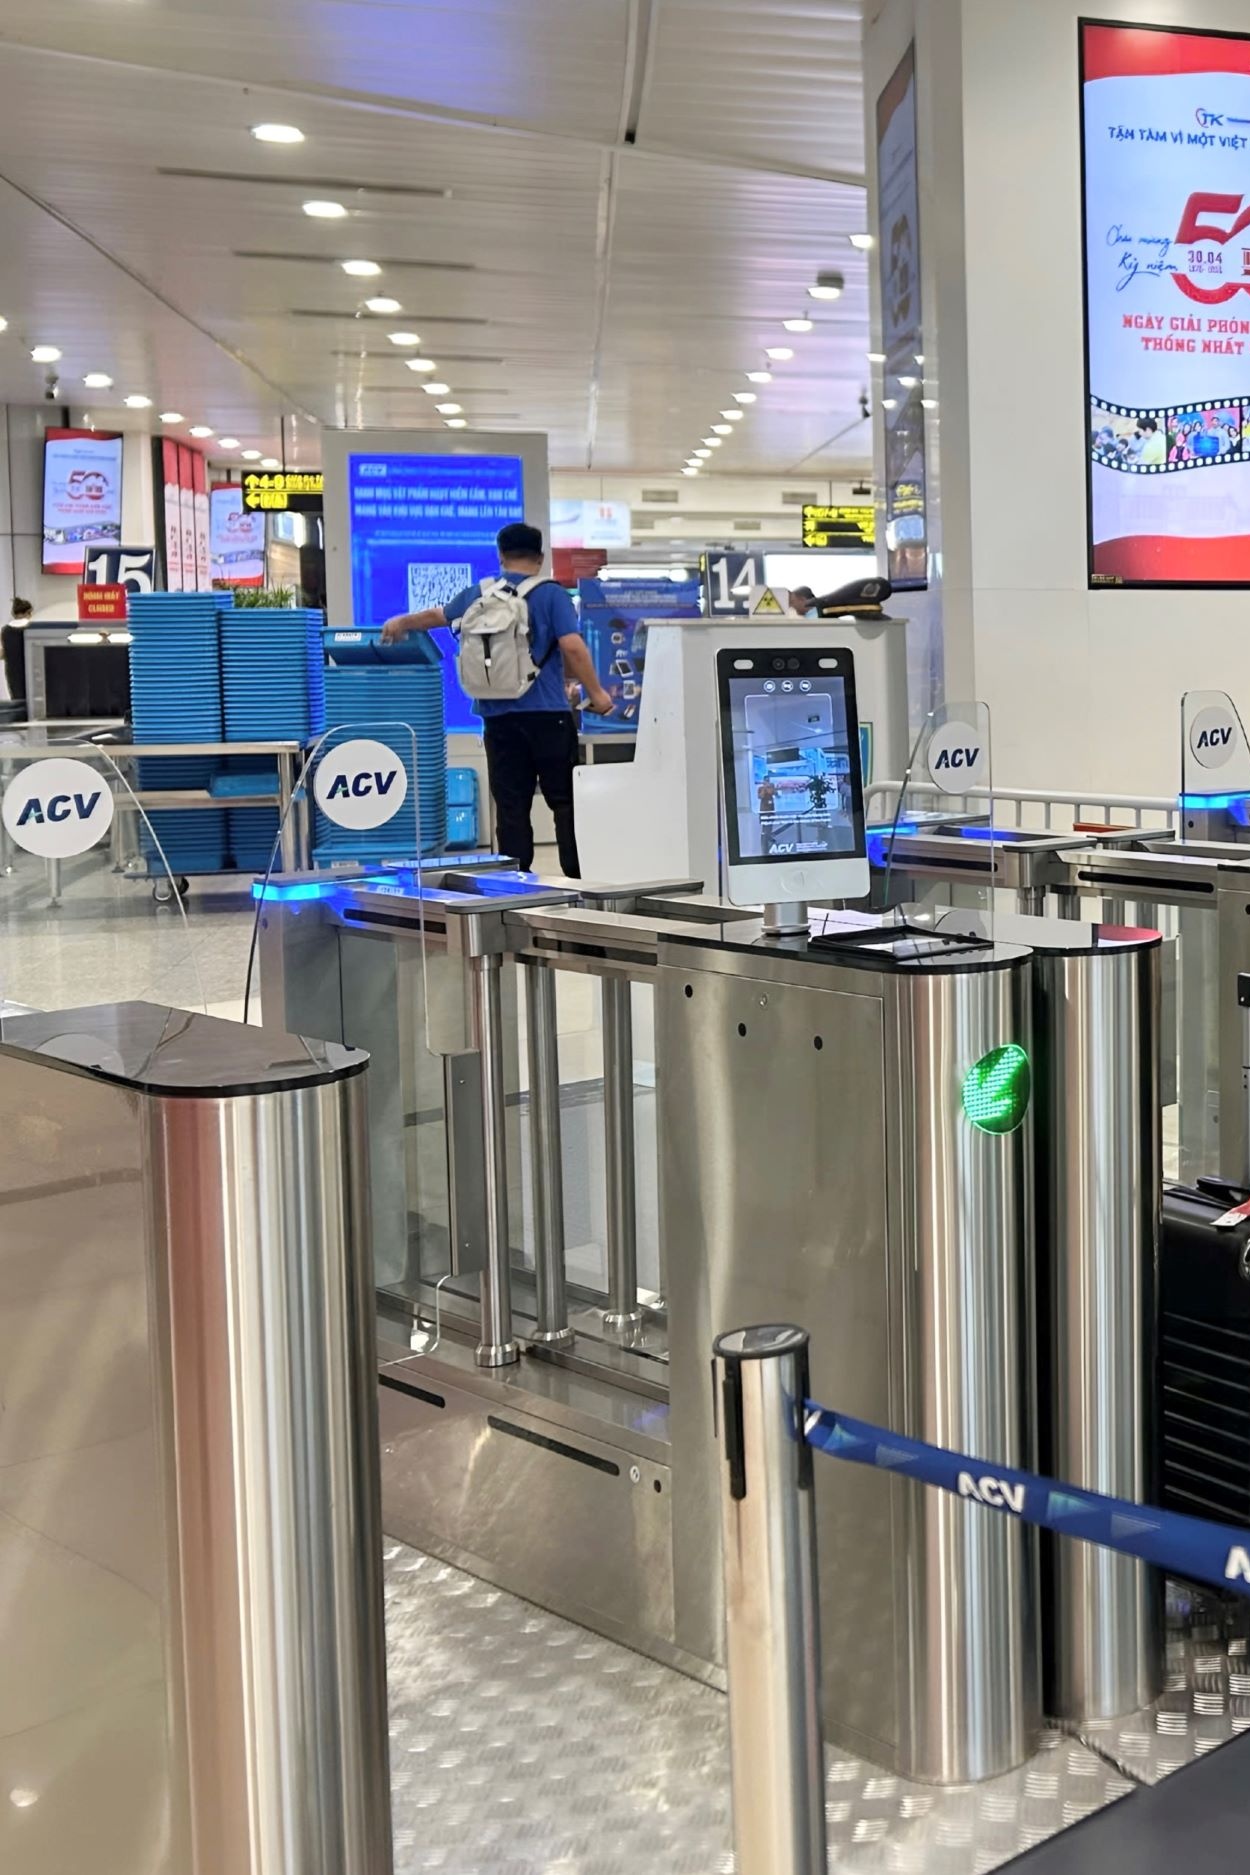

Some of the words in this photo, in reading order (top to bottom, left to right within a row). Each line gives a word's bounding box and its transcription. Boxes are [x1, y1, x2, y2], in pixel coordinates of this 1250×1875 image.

[1187, 131, 1216, 149] MỘT
[1219, 134, 1248, 151] VIỆT
[1122, 312, 1164, 330] NGÀY
[1170, 313, 1201, 332] GIẢI
[1141, 333, 1196, 353] THỐNG
[1202, 336, 1245, 355] NHẤT
[88, 553, 152, 594] 15
[712, 557, 756, 609] 14
[1197, 727, 1232, 748] ACV
[935, 748, 979, 769] ACV
[327, 770, 397, 799] ACV
[16, 792, 101, 826] ACV
[769, 843, 794, 854] ACV
[957, 1471, 1026, 1513] ACV
